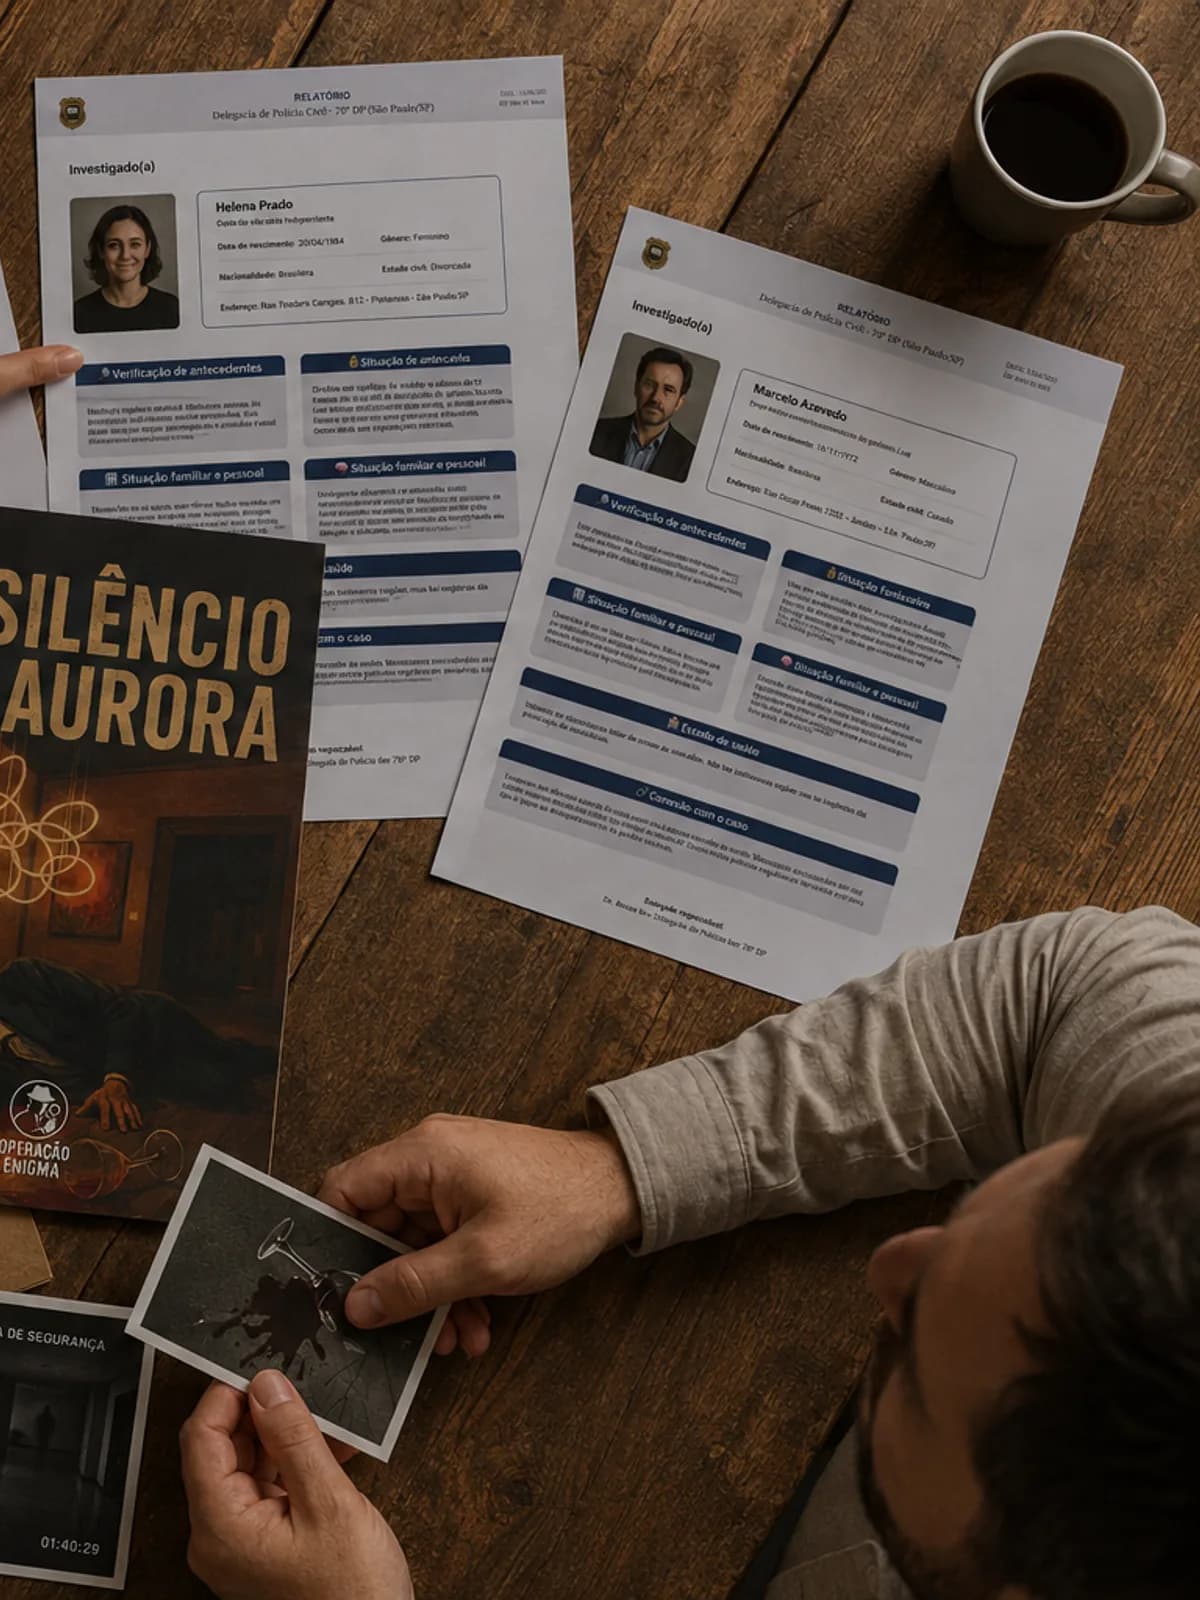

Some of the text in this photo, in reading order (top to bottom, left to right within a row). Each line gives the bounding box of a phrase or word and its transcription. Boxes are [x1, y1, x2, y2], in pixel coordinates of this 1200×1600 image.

[69, 160, 155, 177] Investigado(a)
[215, 199, 294, 213] Helena Prado
[173, 365, 187, 377] de
[753, 383, 799, 407] Marcelo
[337, 635, 344, 643] o
[347, 633, 372, 643] caso
[1, 657, 279, 762] AURORA
[4, 1157, 58, 1178] ENIGMA
[8, 1328, 23, 1340] DE
[27, 1331, 104, 1352] SEGURANÇA
[41, 1536, 99, 1555] 01:40:29
